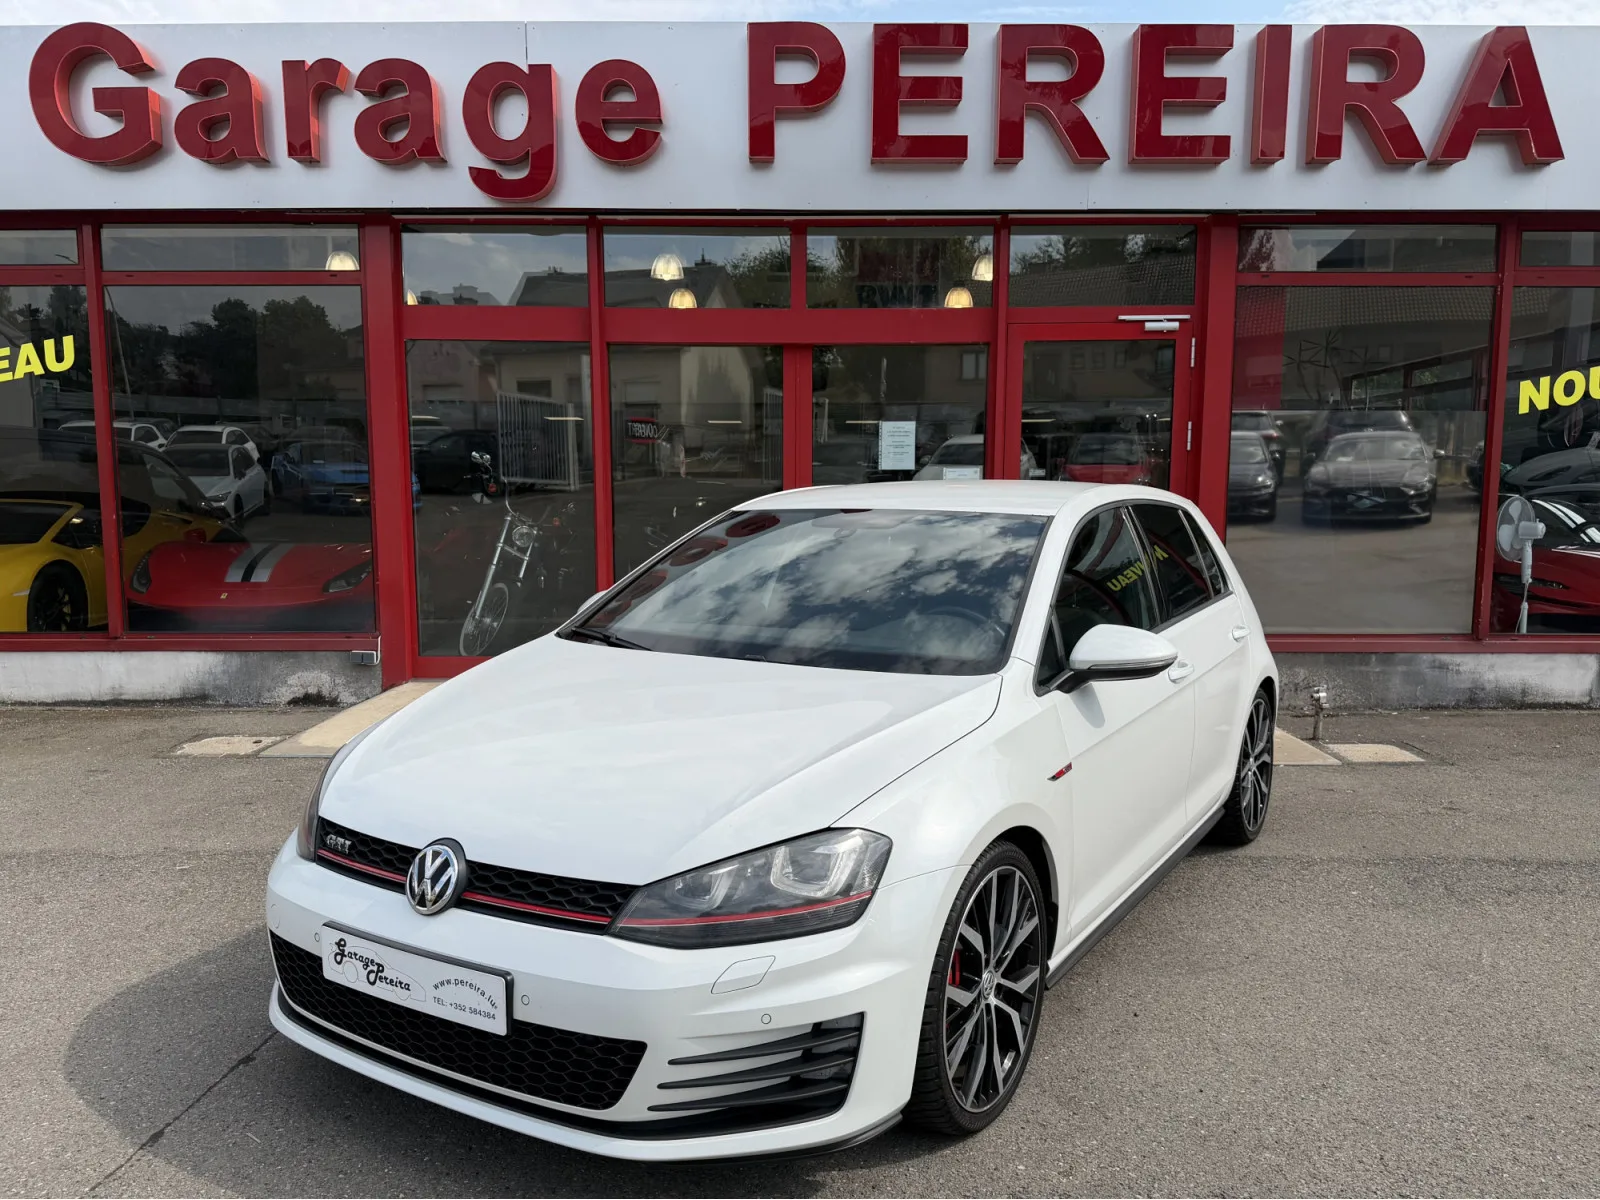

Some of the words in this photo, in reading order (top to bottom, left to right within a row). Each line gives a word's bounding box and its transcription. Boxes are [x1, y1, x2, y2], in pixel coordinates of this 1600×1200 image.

[29, 21, 663, 202] Garage
[747, 22, 1564, 166] PEREIRA
[325, 834, 352, 854] GTI
[406, 844, 459, 916] VW
[334, 938, 376, 970] Garage
[366, 962, 411, 987] Pereira
[433, 996, 448, 1007] TEL:
[449, 1002, 467, 1013] +352
[468, 1006, 496, 1020] 584384
